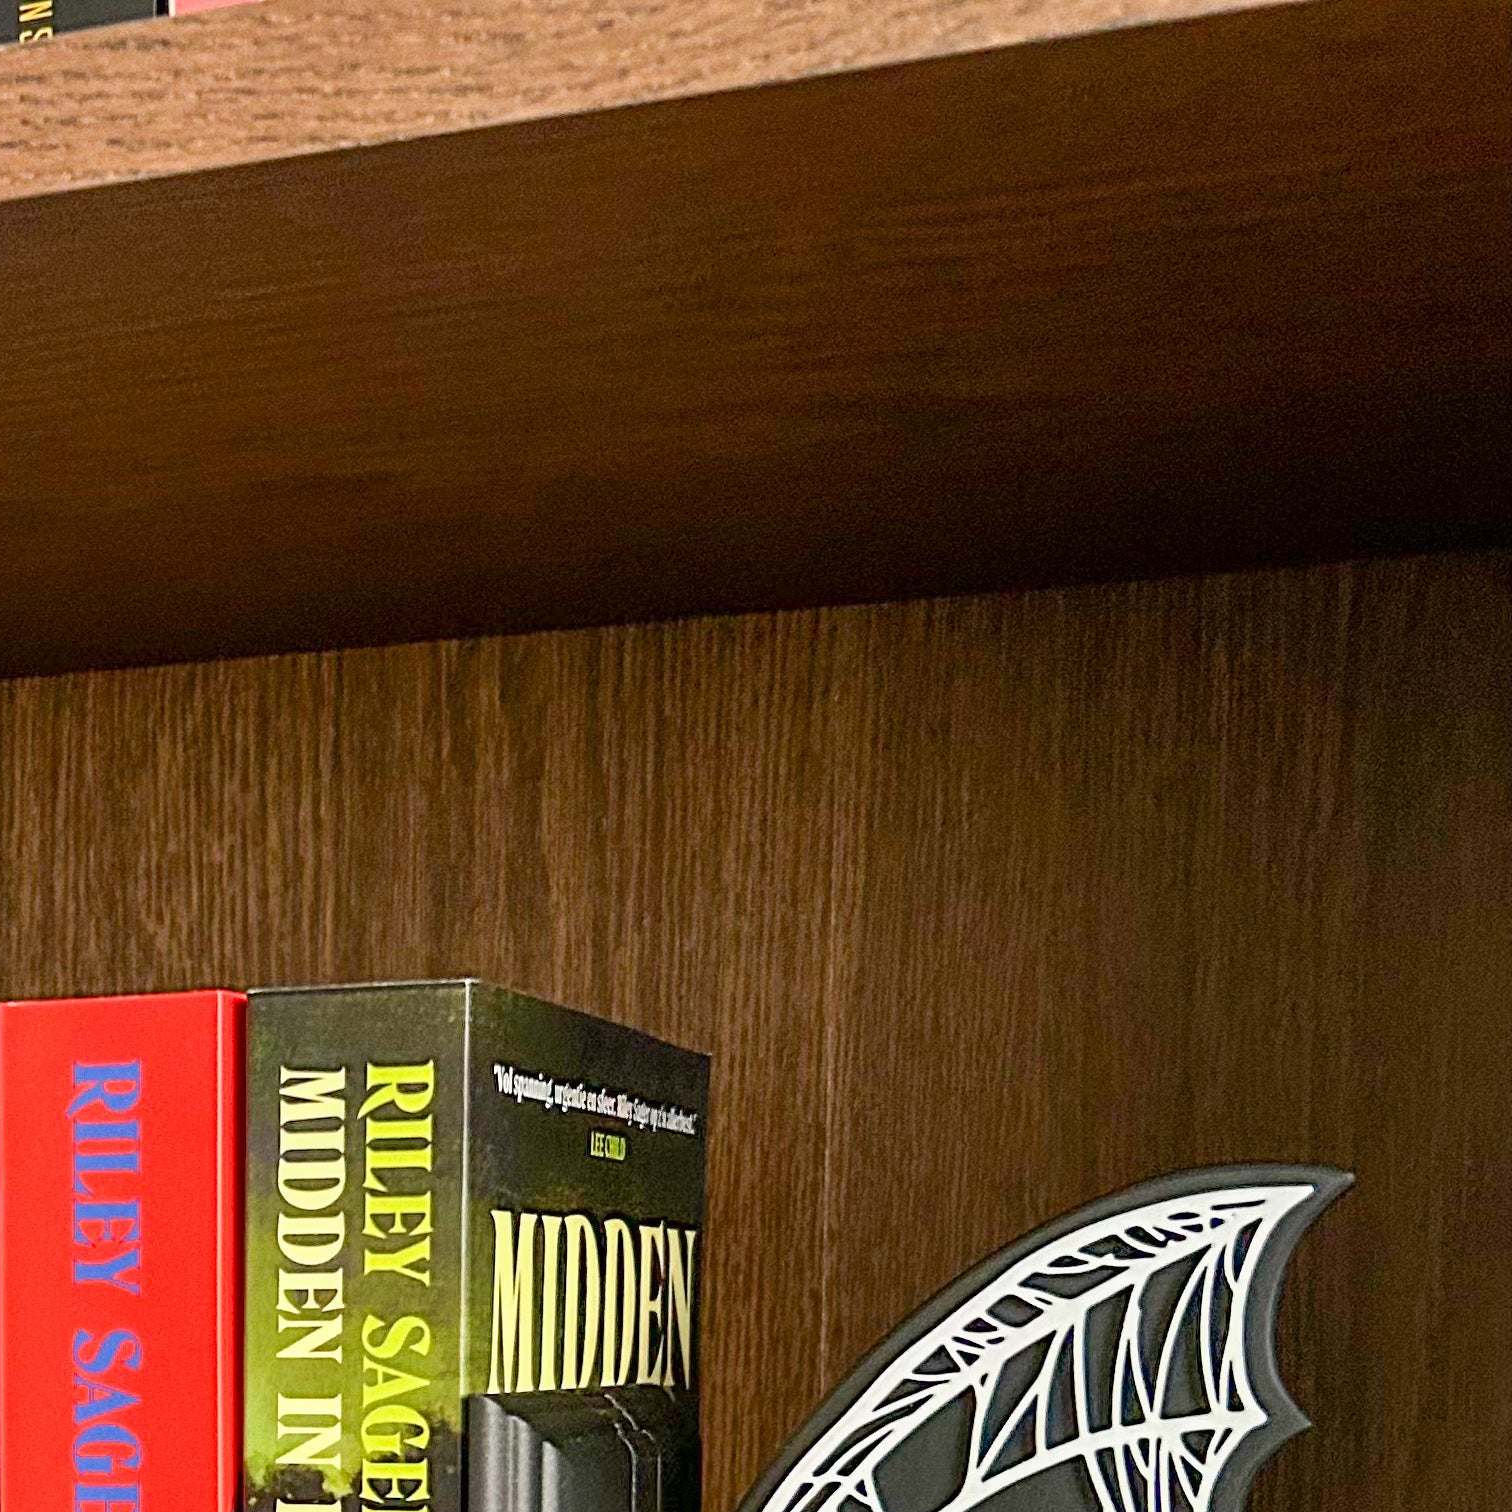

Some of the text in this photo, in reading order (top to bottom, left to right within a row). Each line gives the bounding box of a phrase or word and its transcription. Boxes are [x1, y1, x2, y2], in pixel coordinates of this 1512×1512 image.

[65, 1059, 140, 1297] RILEY
[275, 1065, 346, 1365] MIDDEN
[357, 1059, 436, 1287] RILEY
[487, 1209, 697, 1394] MIDDEN
[276, 1393, 343, 1469] IN
